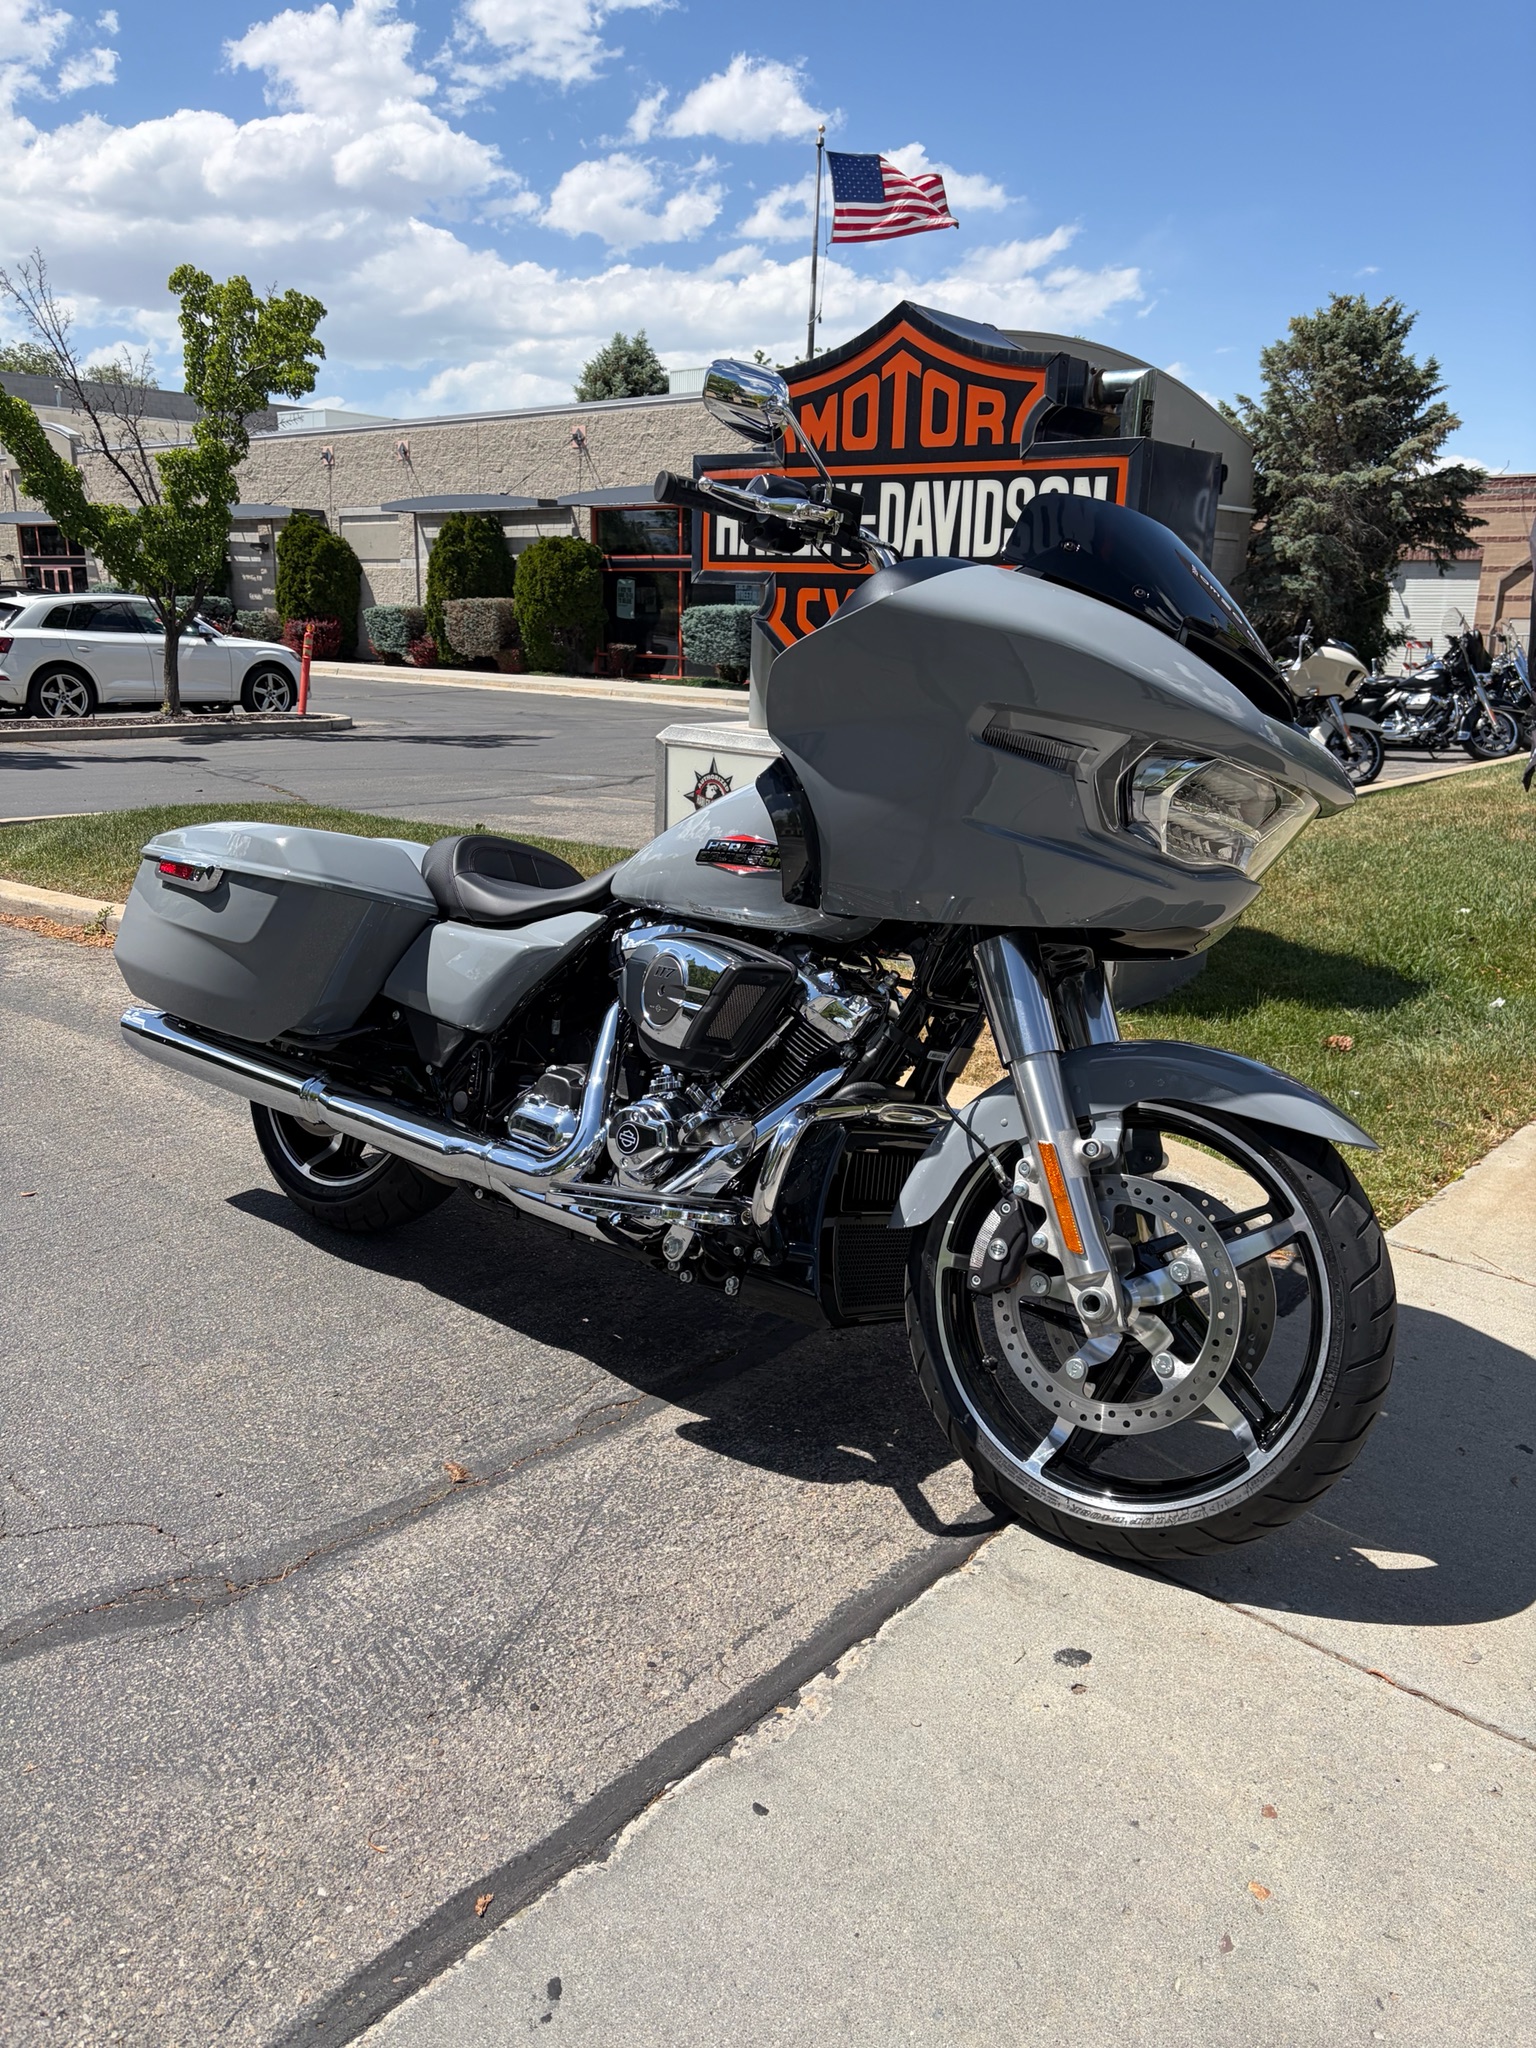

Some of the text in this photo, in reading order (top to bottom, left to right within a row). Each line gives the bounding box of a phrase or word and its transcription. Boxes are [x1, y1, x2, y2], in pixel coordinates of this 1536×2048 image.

[800, 350, 1007, 453] MOTOR
[716, 475, 1109, 559] H-DAVIDSON
[697, 774, 730, 793] AUTHORIZED
[653, 965, 678, 979] 117
